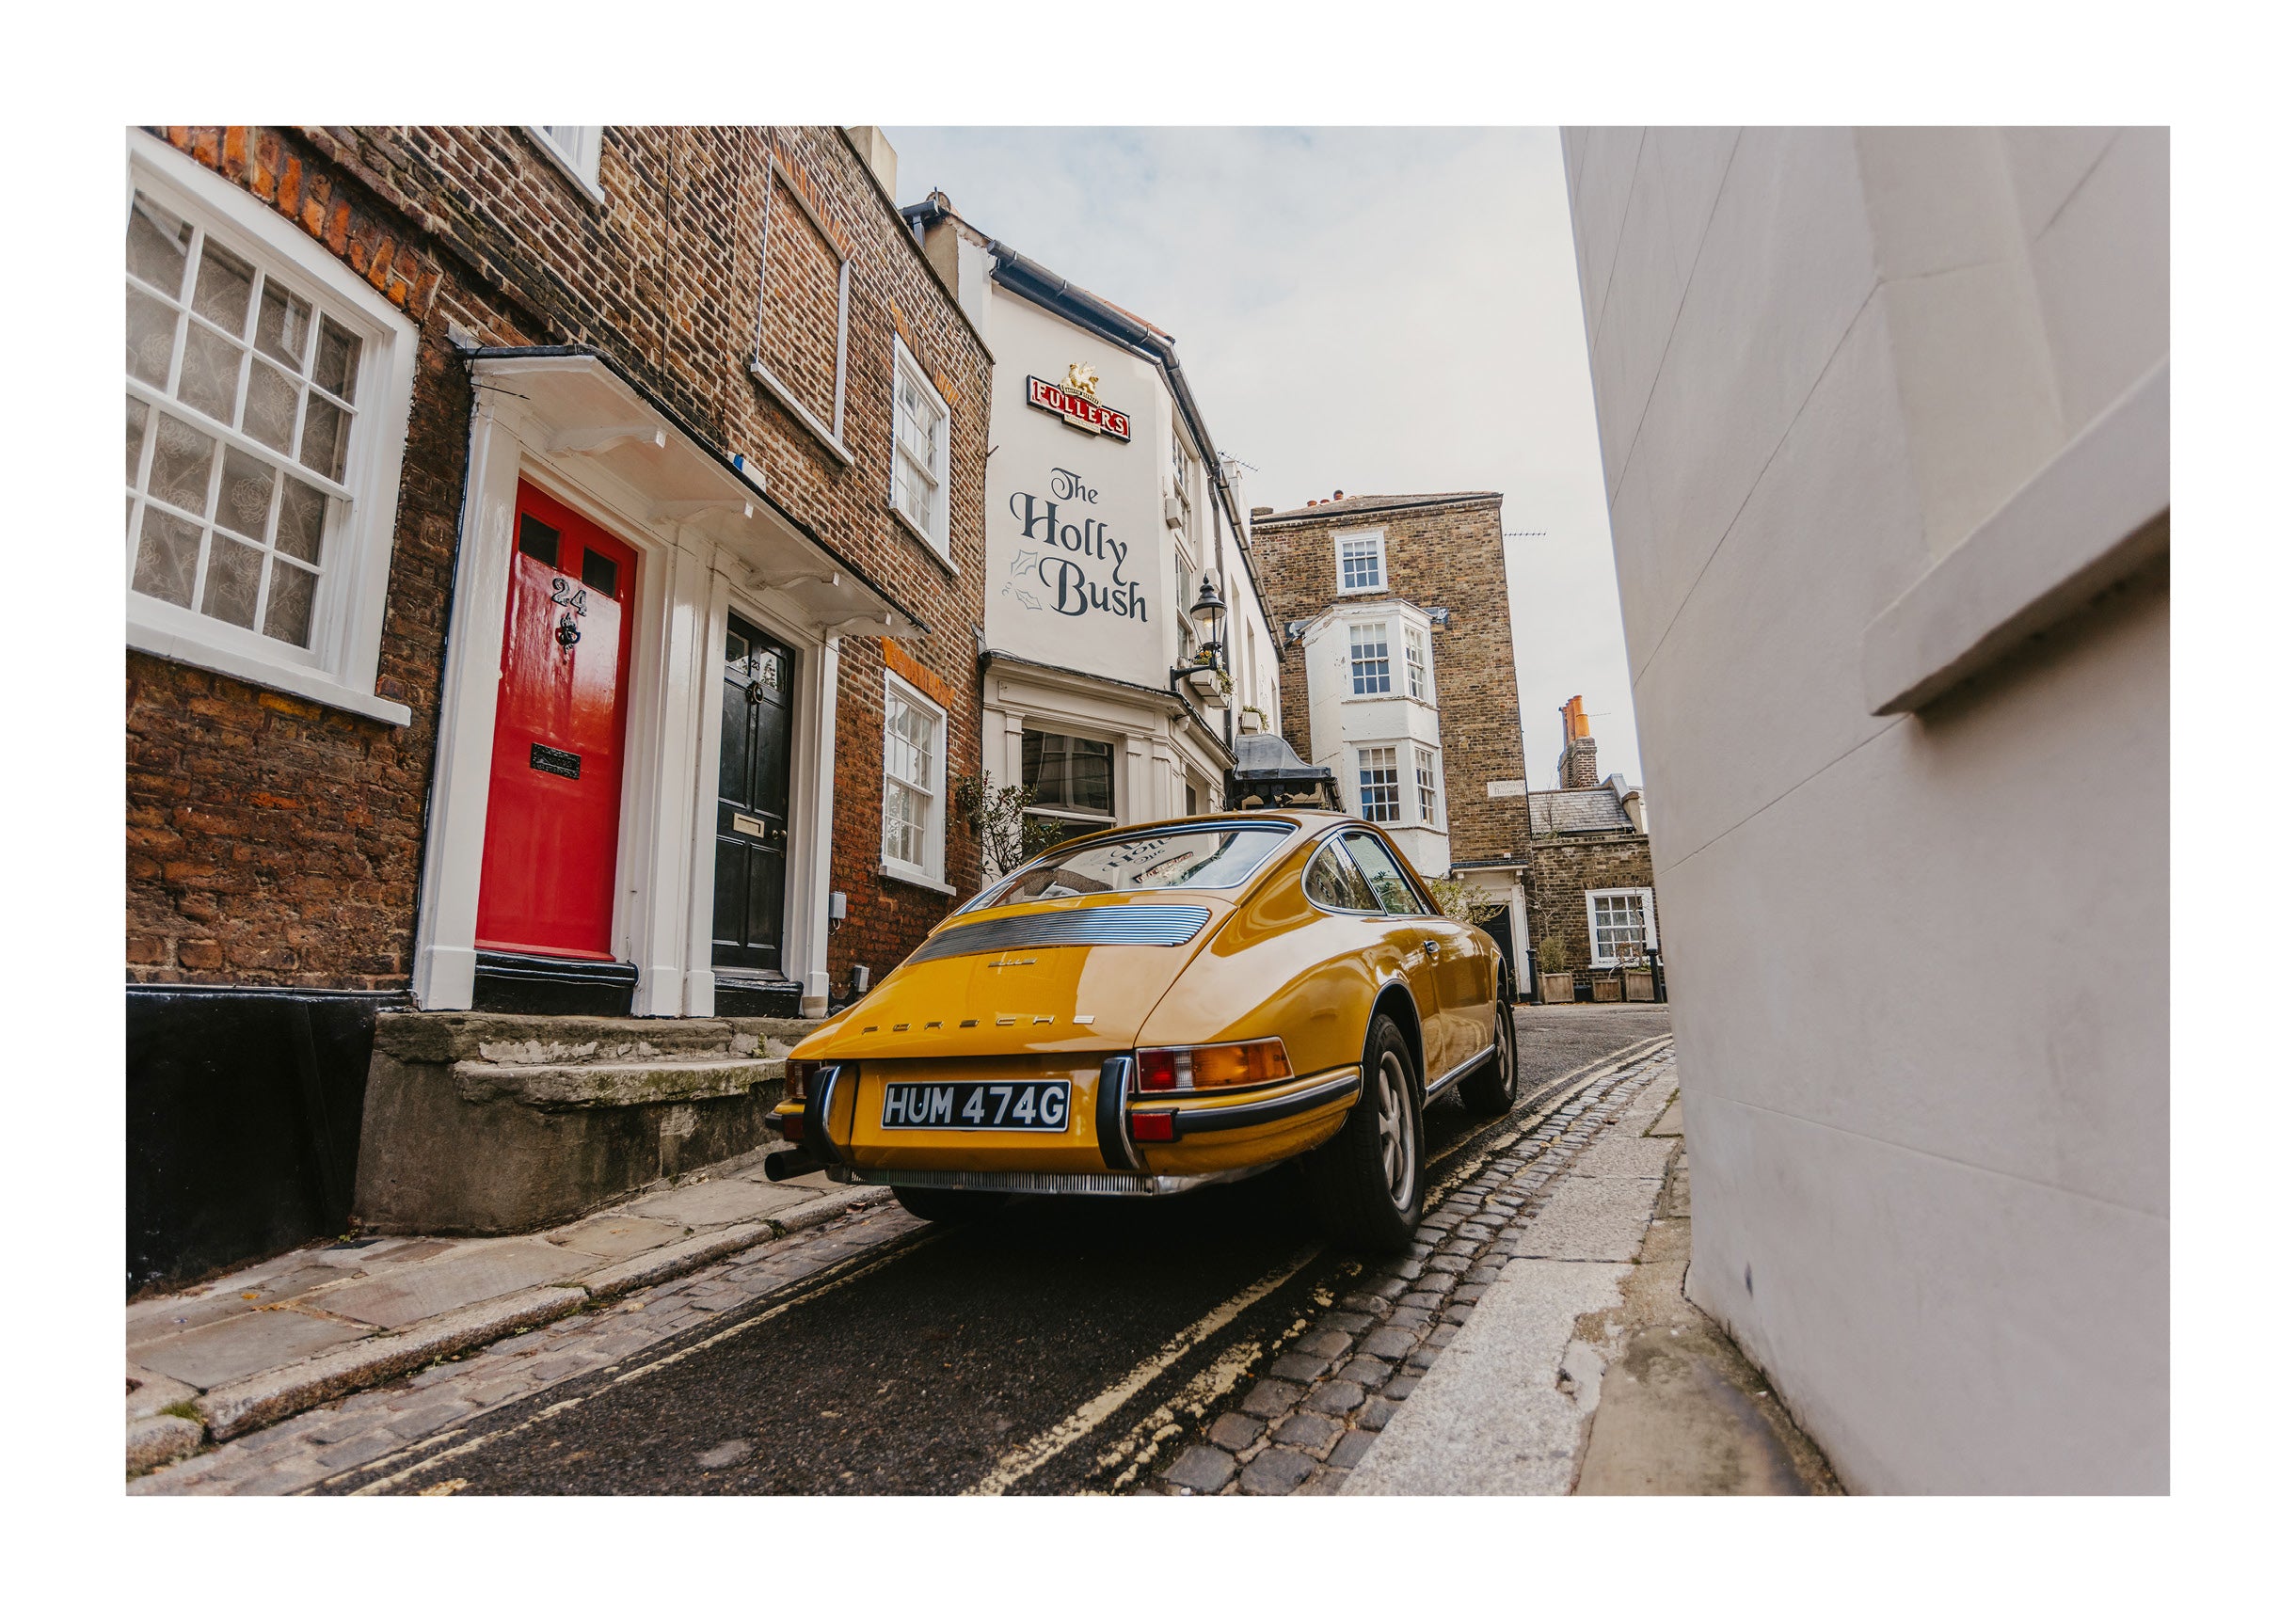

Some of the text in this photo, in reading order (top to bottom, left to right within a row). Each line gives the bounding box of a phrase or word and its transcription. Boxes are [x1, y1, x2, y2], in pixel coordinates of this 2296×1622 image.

[1051, 468, 1098, 504] The
[1010, 492, 1127, 586] Holly
[551, 578, 586, 617] 24
[1039, 557, 1148, 622] Bush
[752, 660, 760, 671] 23
[862, 1015, 1095, 1035] PORSCHE
[885, 1086, 1065, 1125] HUM 474G
